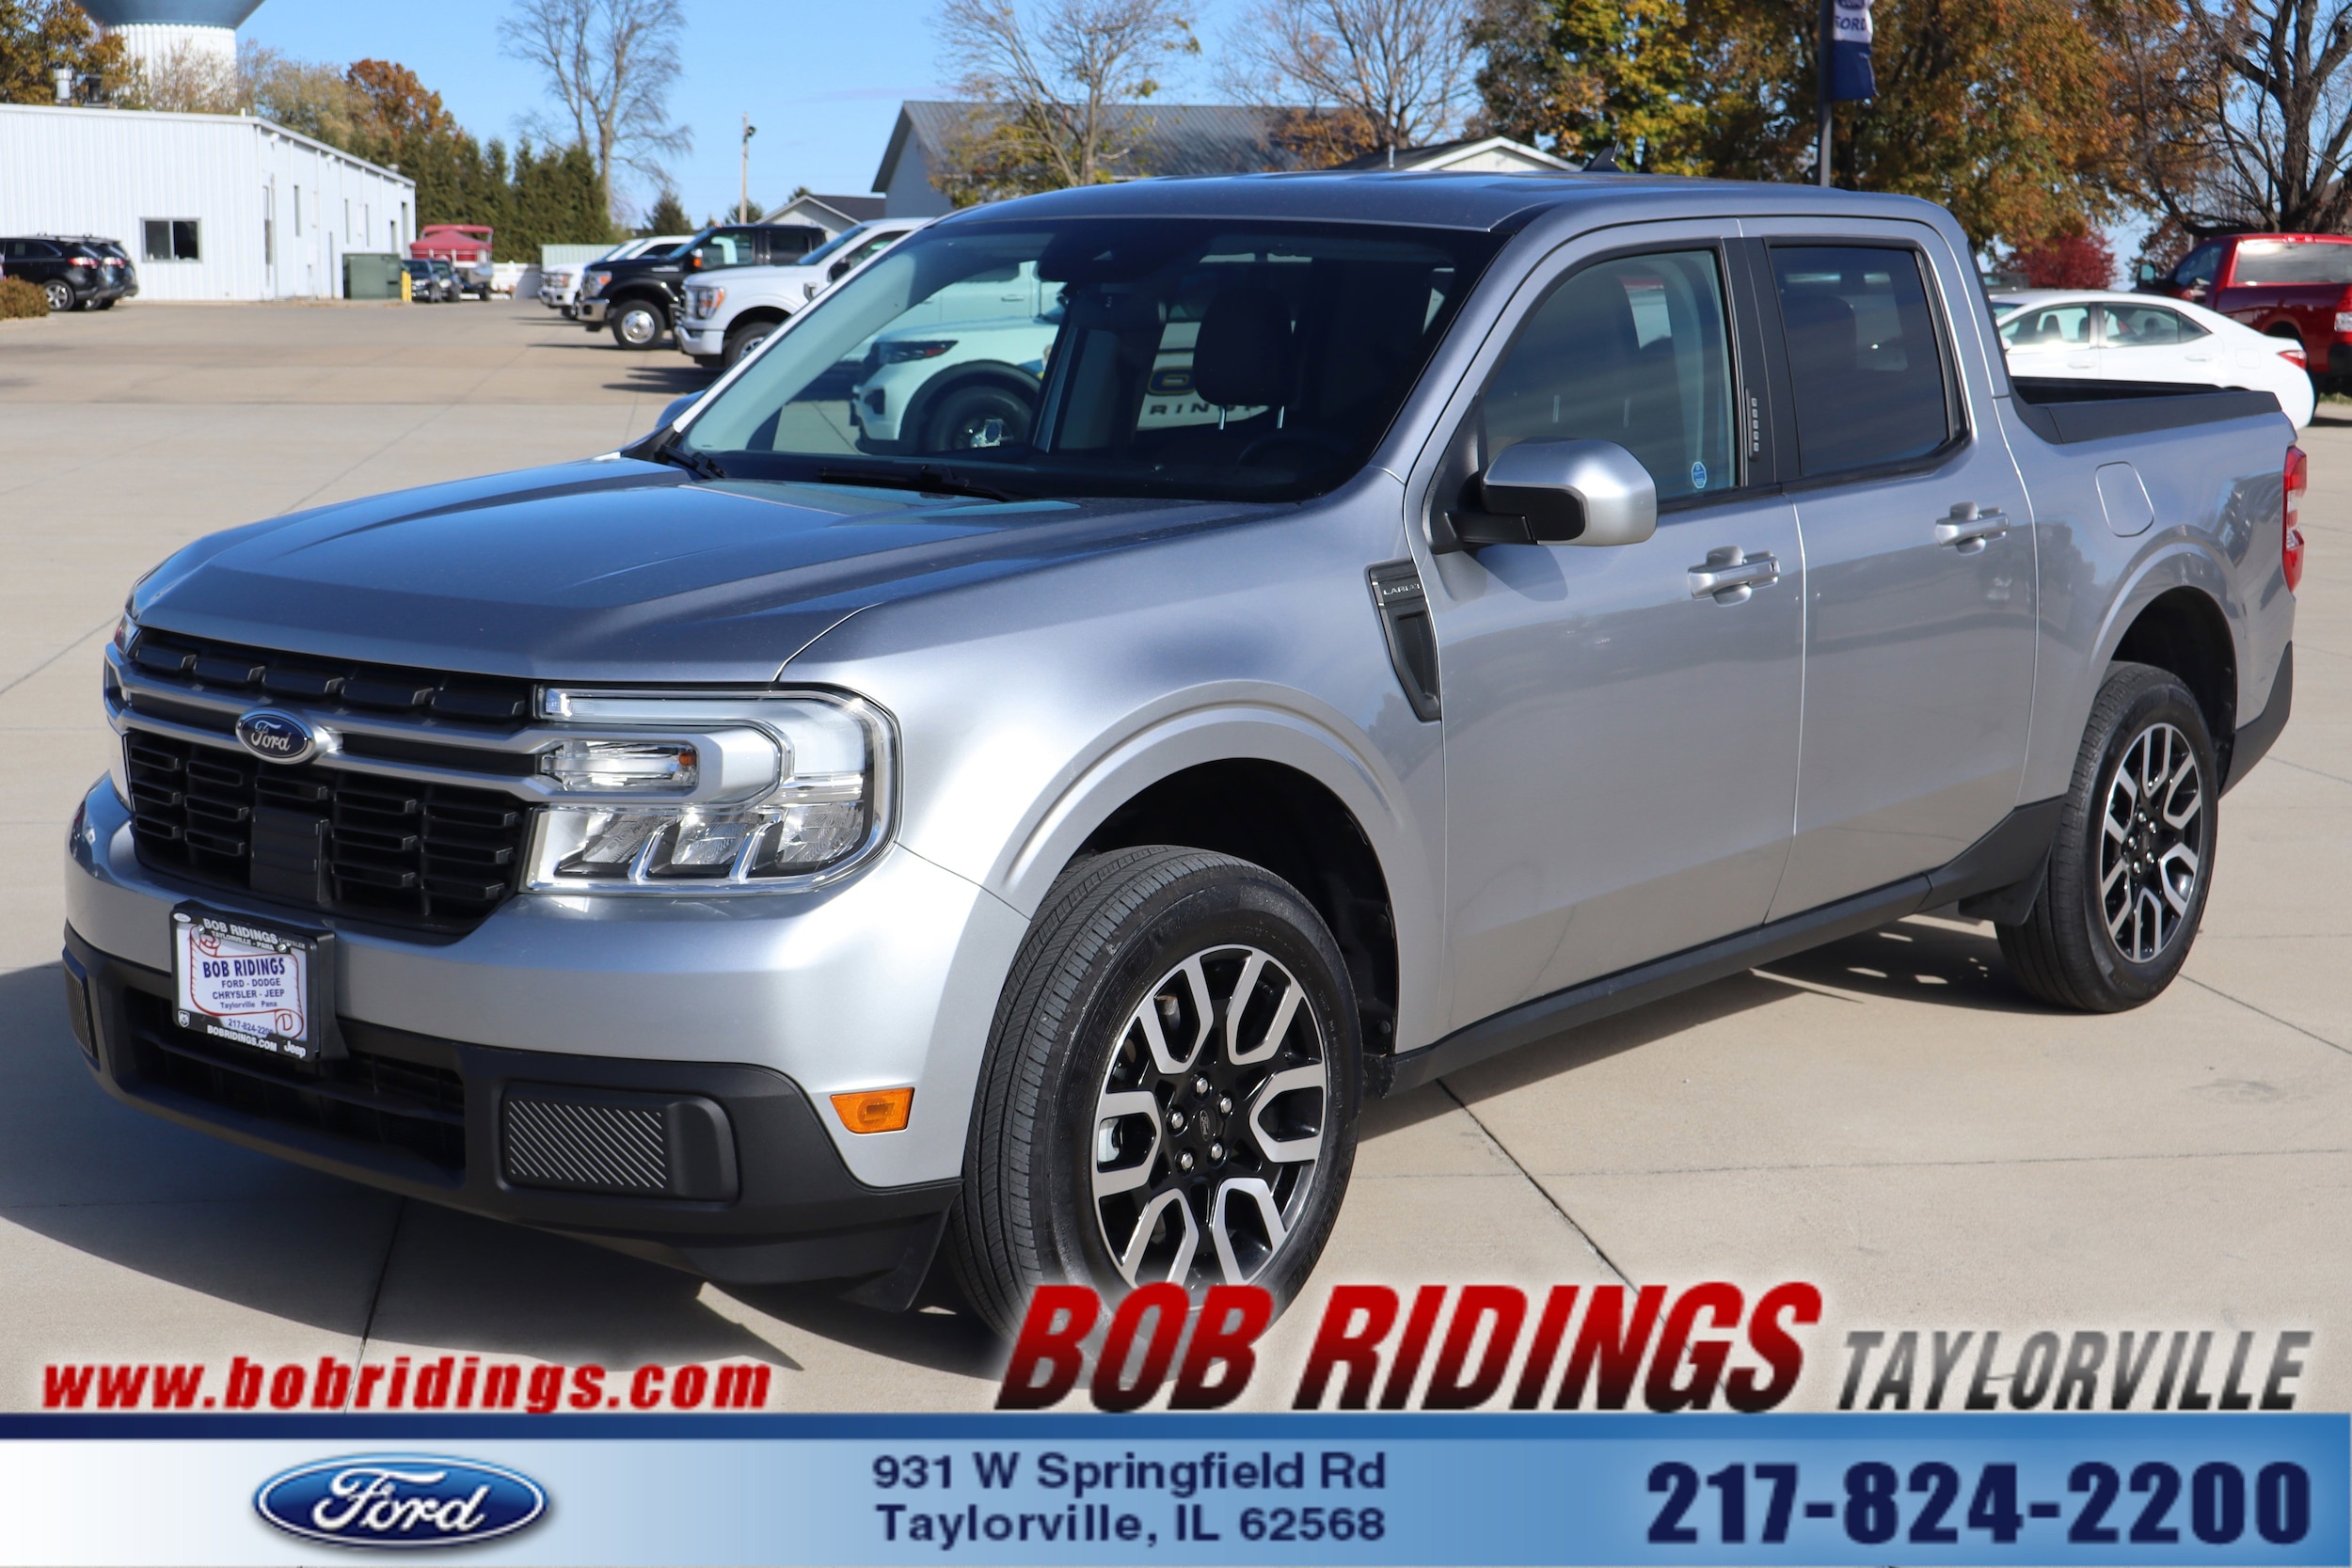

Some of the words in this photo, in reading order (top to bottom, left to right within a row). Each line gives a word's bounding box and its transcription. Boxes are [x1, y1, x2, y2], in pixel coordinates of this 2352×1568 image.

[250, 720, 292, 752] Ford
[203, 918, 228, 934] BOB
[230, 924, 278, 944] RIDINGS
[202, 960, 230, 978] BOB
[234, 957, 285, 976] RIDINGS
[221, 979, 245, 989] FORD
[251, 977, 281, 988] DODGE
[212, 990, 257, 1000] CHRYSLER
[264, 989, 285, 998] JEEP
[220, 1002, 255, 1010] Taylorville
[207, 1024, 278, 1053] BOBRIDINGS.COM
[283, 1040, 307, 1059] Jeep
